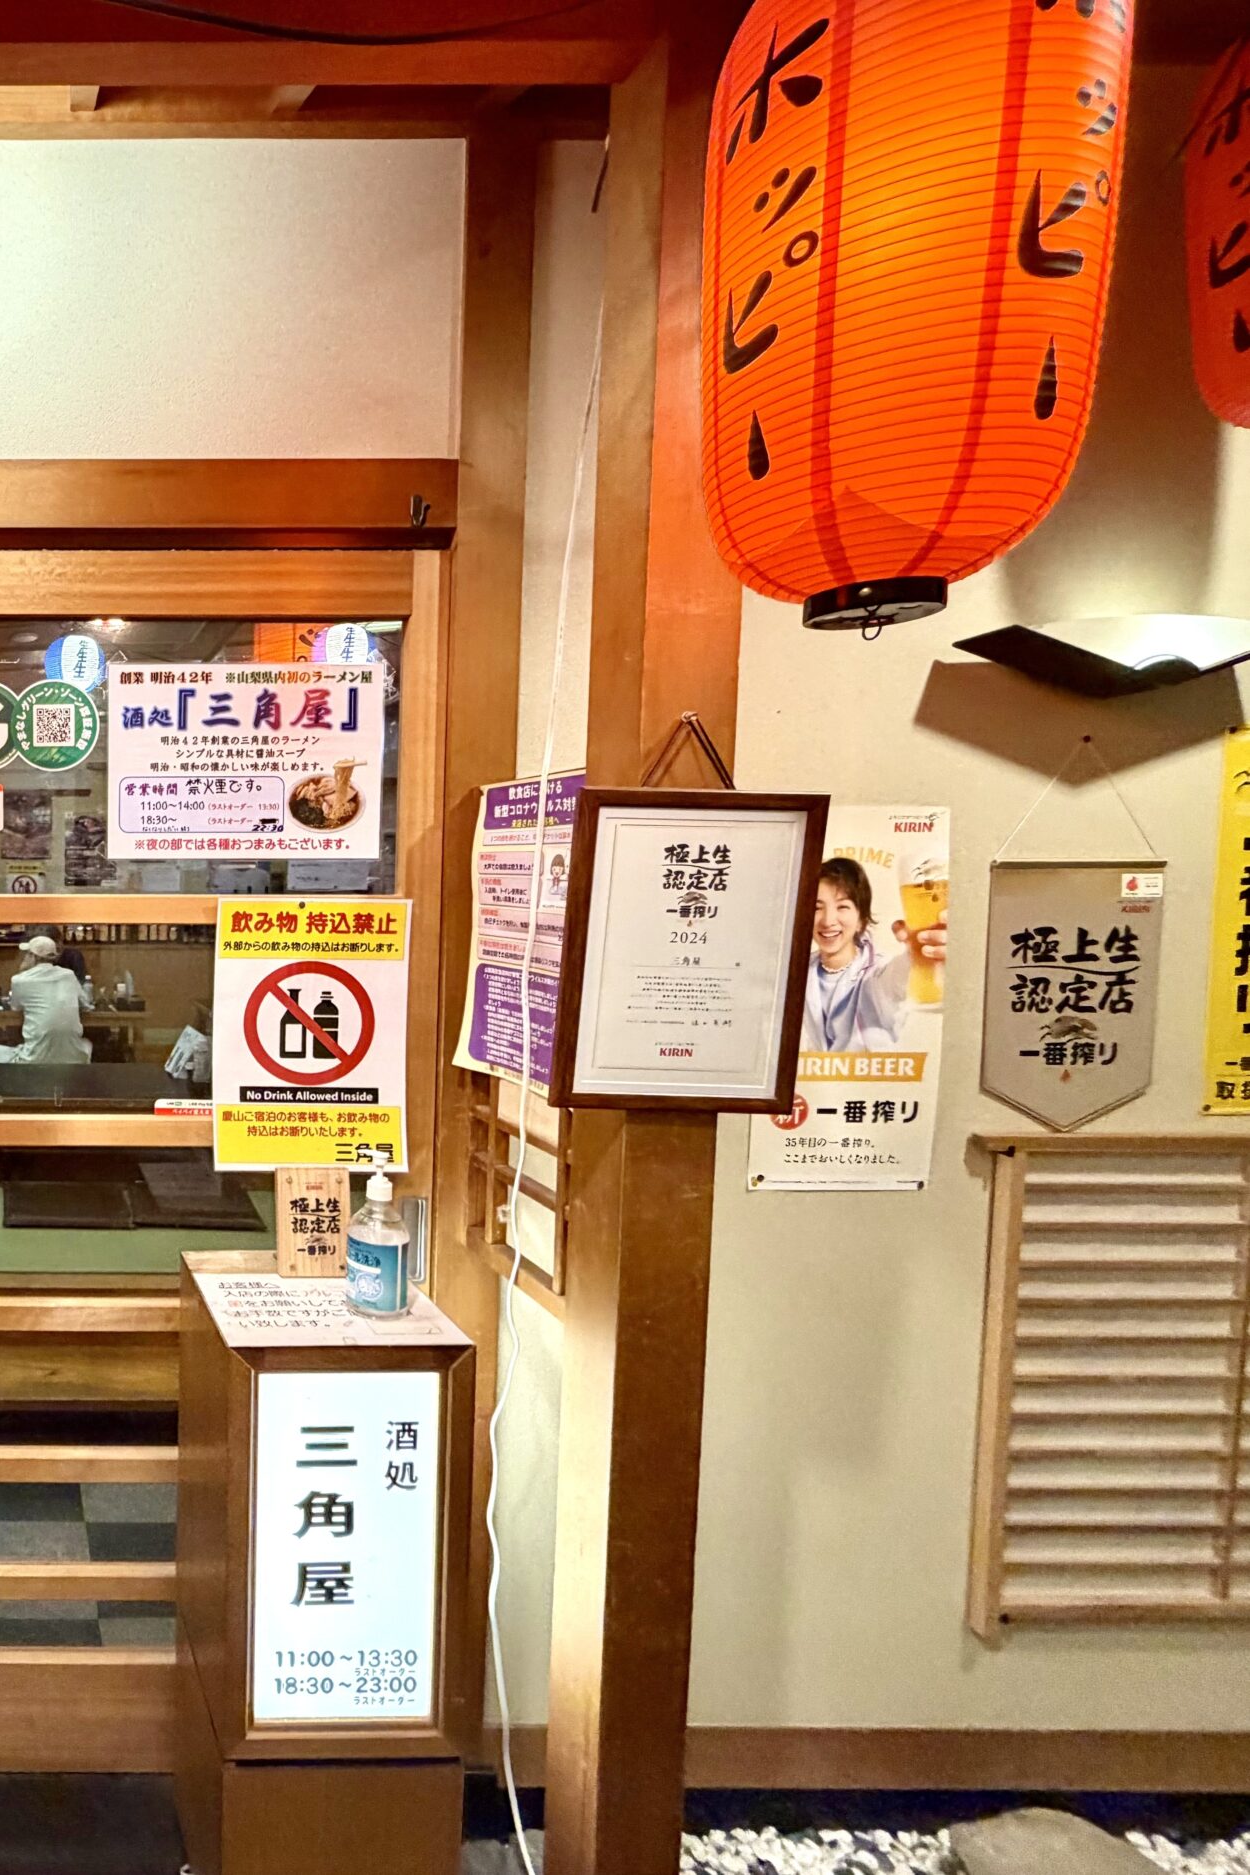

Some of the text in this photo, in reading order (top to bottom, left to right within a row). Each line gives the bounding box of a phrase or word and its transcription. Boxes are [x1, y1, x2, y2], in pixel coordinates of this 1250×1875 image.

[119, 671, 144, 685] 創業
[124, 783, 178, 796] 営業時間
[509, 781, 562, 800] 飲食店にける
[894, 822, 933, 833] KIRIN
[134, 839, 350, 851] ※夜の部では各種おつまみもございます。
[662, 843, 732, 866] 極上生
[661, 868, 729, 892] 認定店
[666, 905, 719, 919] 一番搾り
[230, 911, 398, 935] 飲み物 持込禁止
[223, 941, 399, 953] 外部からの飲み物の持込はお断りします。
[670, 931, 708, 945] 2024
[1009, 924, 1142, 964] 極上生
[1008, 972, 1137, 1014] 認定店
[659, 1047, 694, 1057] KIRIN
[1019, 1042, 1118, 1066] 一番搾り
[798, 1057, 916, 1076] IRIN BEER
[246, 1090, 374, 1102] No Drink Allowed Inside
[816, 1100, 919, 1123] 一番搾り
[247, 1125, 363, 1137] 持込はお断りいたします。
[289, 1197, 341, 1213] 極上生
[290, 1216, 341, 1234] 認定店
[384, 1420, 420, 1492] 酒処
[290, 1426, 358, 1608] 三角屋
[274, 1649, 418, 1668] 11:00～13:30
[274, 1676, 418, 1695] 18:30～23:00
